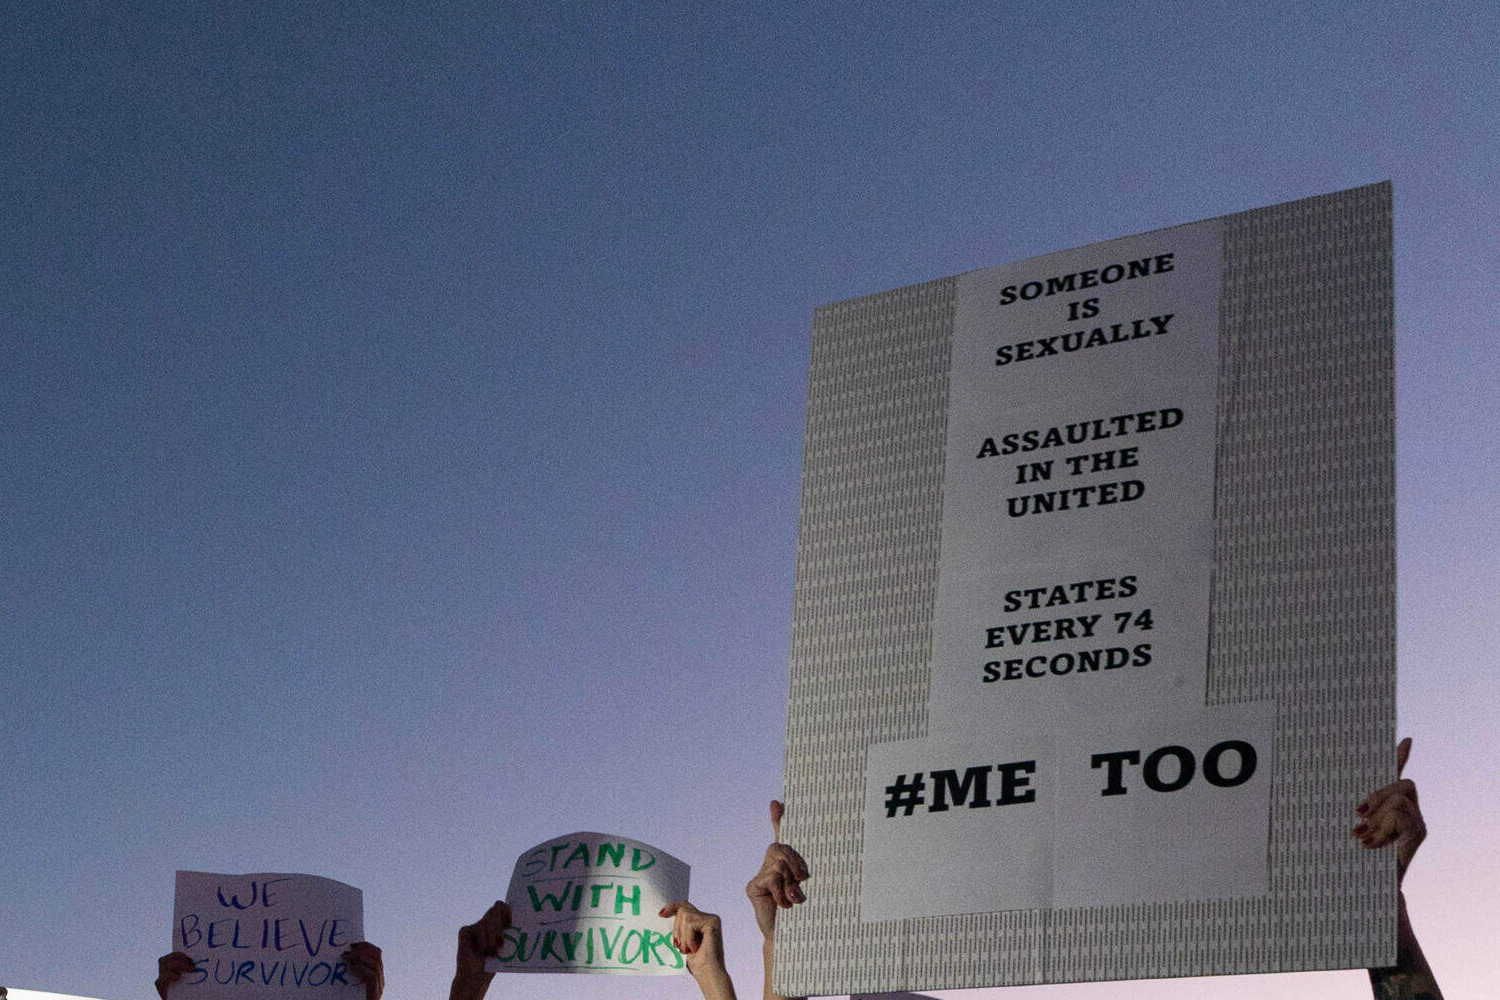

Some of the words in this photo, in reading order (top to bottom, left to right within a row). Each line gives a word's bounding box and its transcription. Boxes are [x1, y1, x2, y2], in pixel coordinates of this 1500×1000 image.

[999, 253, 1175, 306] SOMEONE
[1066, 298, 1100, 321] IS
[995, 314, 1174, 366] SEXUALLY
[976, 407, 1184, 459] ASSAULTED
[1015, 460, 1054, 485] IN
[1066, 446, 1140, 476] THE
[1007, 479, 1145, 518] UNITED
[1003, 575, 1139, 613] STATES
[984, 614, 1102, 649] EVERY
[1113, 608, 1155, 634] 74
[982, 643, 1153, 683] SECONDS
[885, 759, 1037, 819] #ME
[1090, 739, 1258, 798] TOO
[521, 842, 656, 877] STAND
[217, 877, 292, 910] WE
[527, 881, 642, 917] WITH
[180, 914, 350, 957] BELIEVE
[498, 924, 685, 970] SURVIVORS
